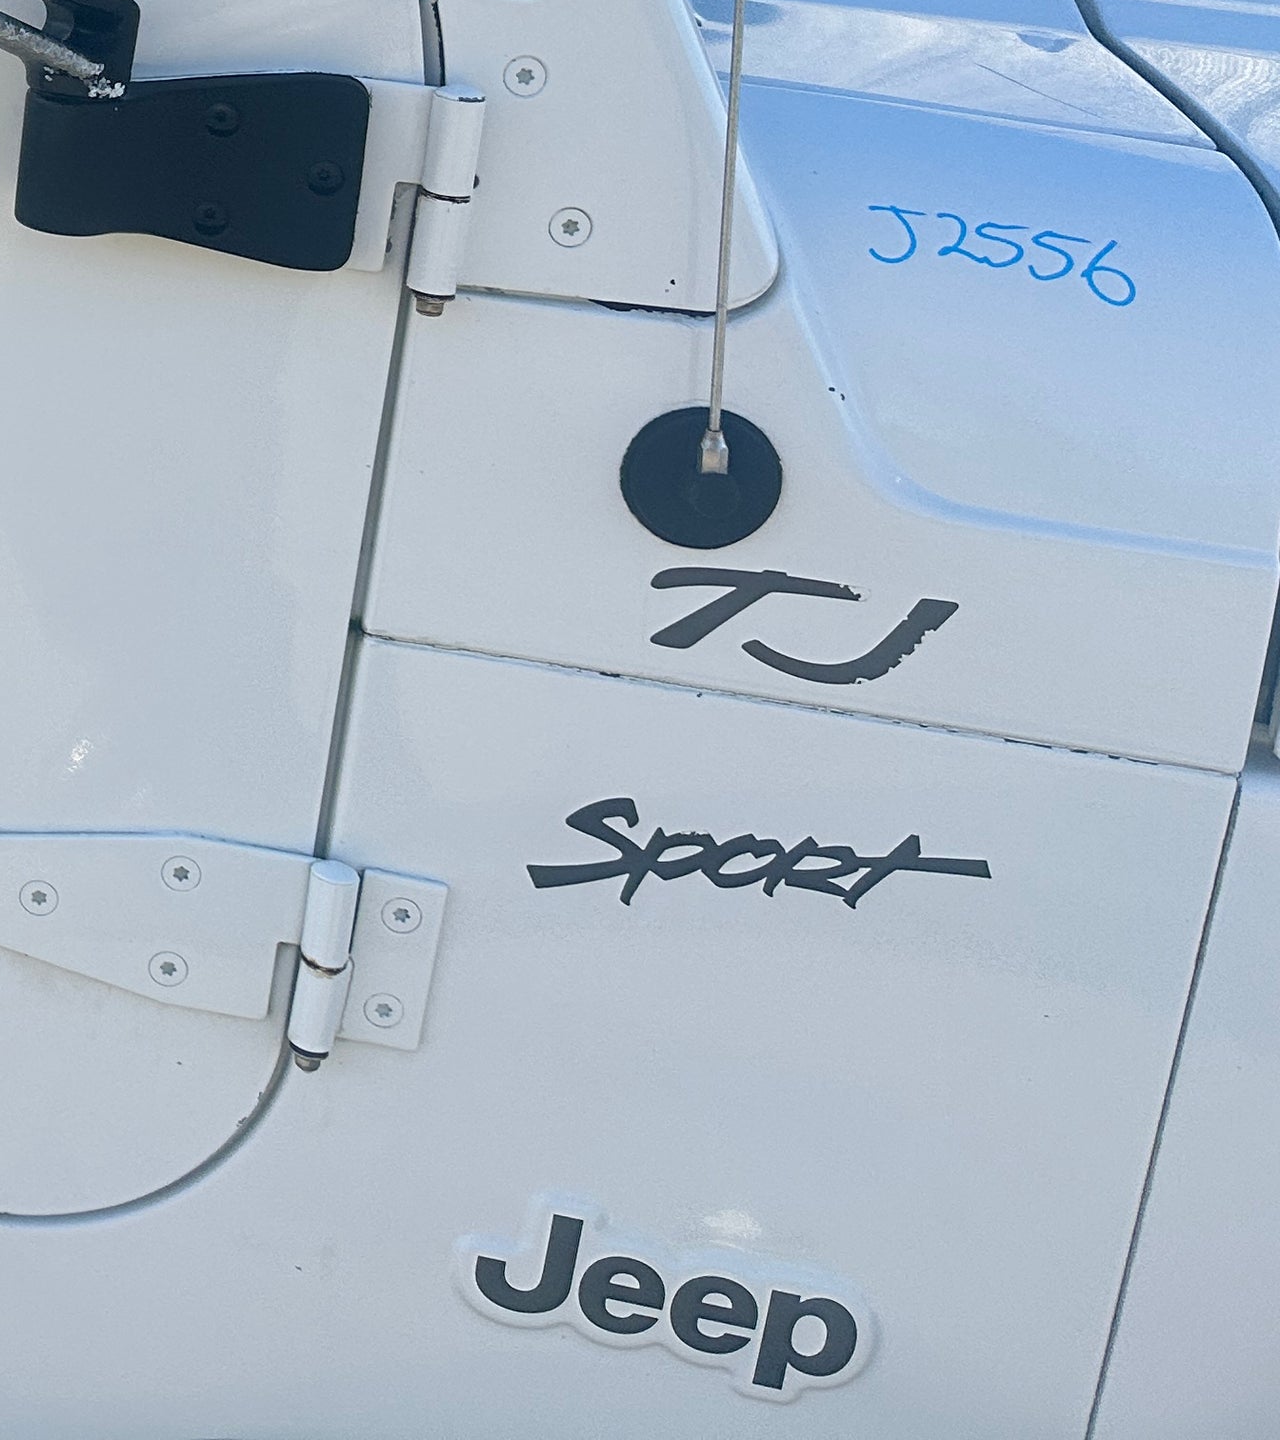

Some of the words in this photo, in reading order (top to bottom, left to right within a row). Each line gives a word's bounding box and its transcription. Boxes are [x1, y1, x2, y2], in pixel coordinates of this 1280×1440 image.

[867, 204, 1137, 307] J2556
[649, 566, 960, 686] TJ
[474, 1213, 858, 1391] Jeep
